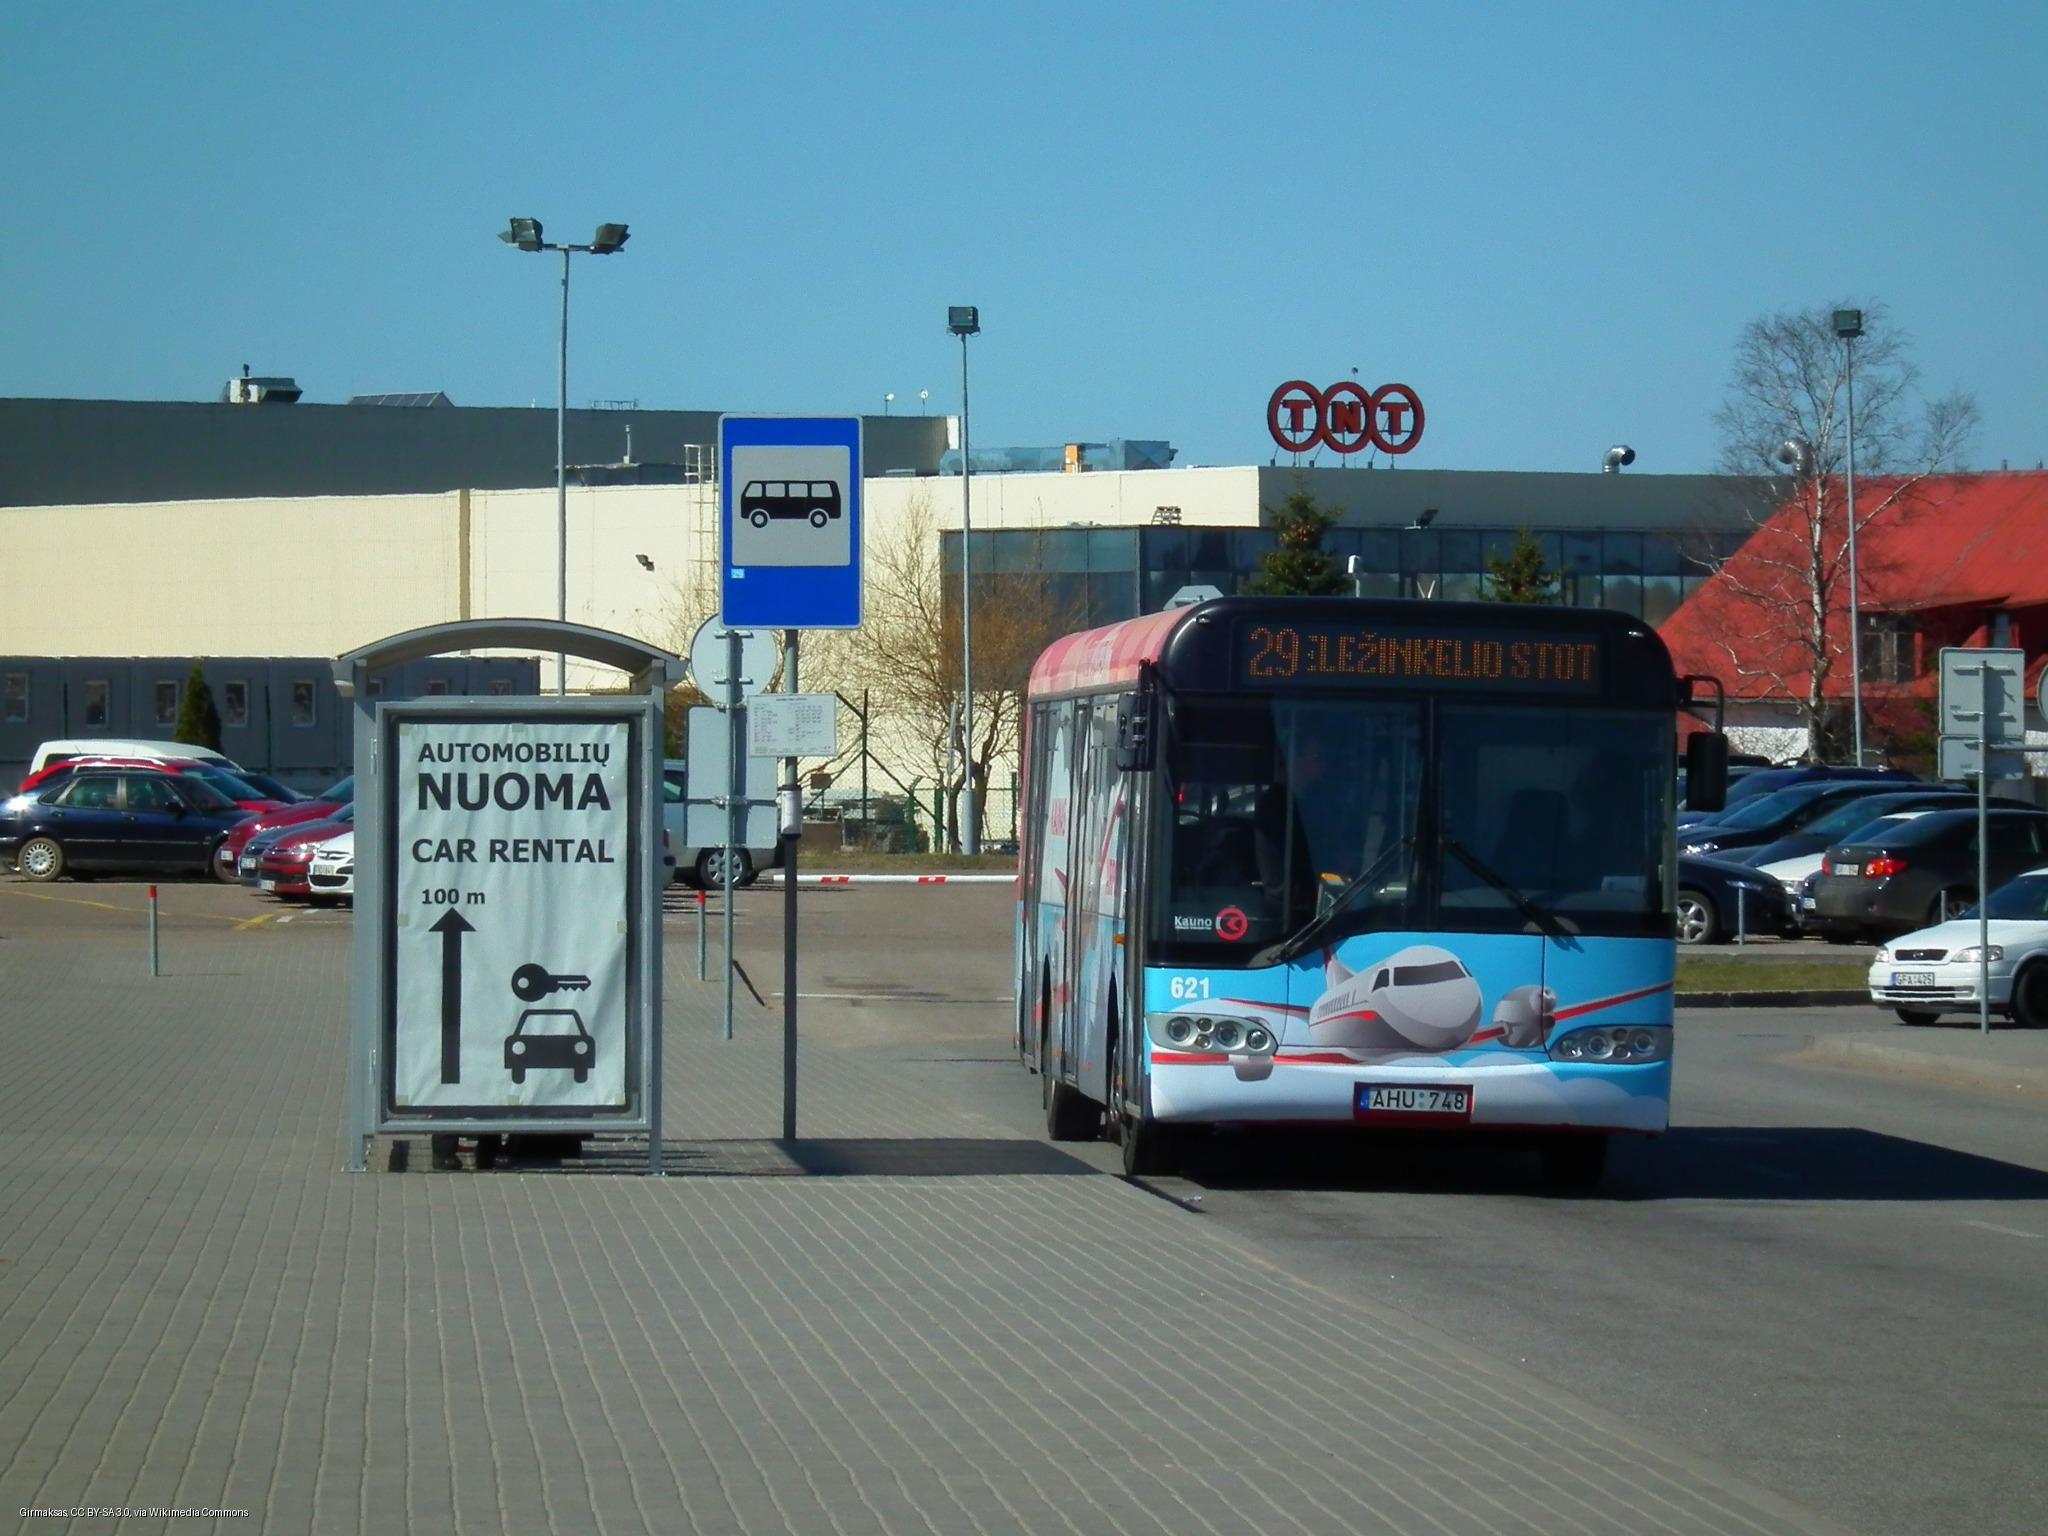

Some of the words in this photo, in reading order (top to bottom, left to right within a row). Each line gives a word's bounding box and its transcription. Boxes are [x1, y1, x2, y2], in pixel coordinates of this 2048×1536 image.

[1248, 626, 1300, 678] 29
[417, 743, 610, 767] AUTOMOBILIŲ
[418, 772, 611, 811] NUOMA
[412, 838, 478, 863] CAR
[489, 839, 614, 863] RENTAL
[421, 888, 460, 905] 100
[466, 892, 486, 905] m
[1174, 915, 1213, 926] Kauno
[1170, 977, 1210, 999] 621
[1372, 1089, 1415, 1109] AHU
[1429, 1092, 1465, 1111] 748
